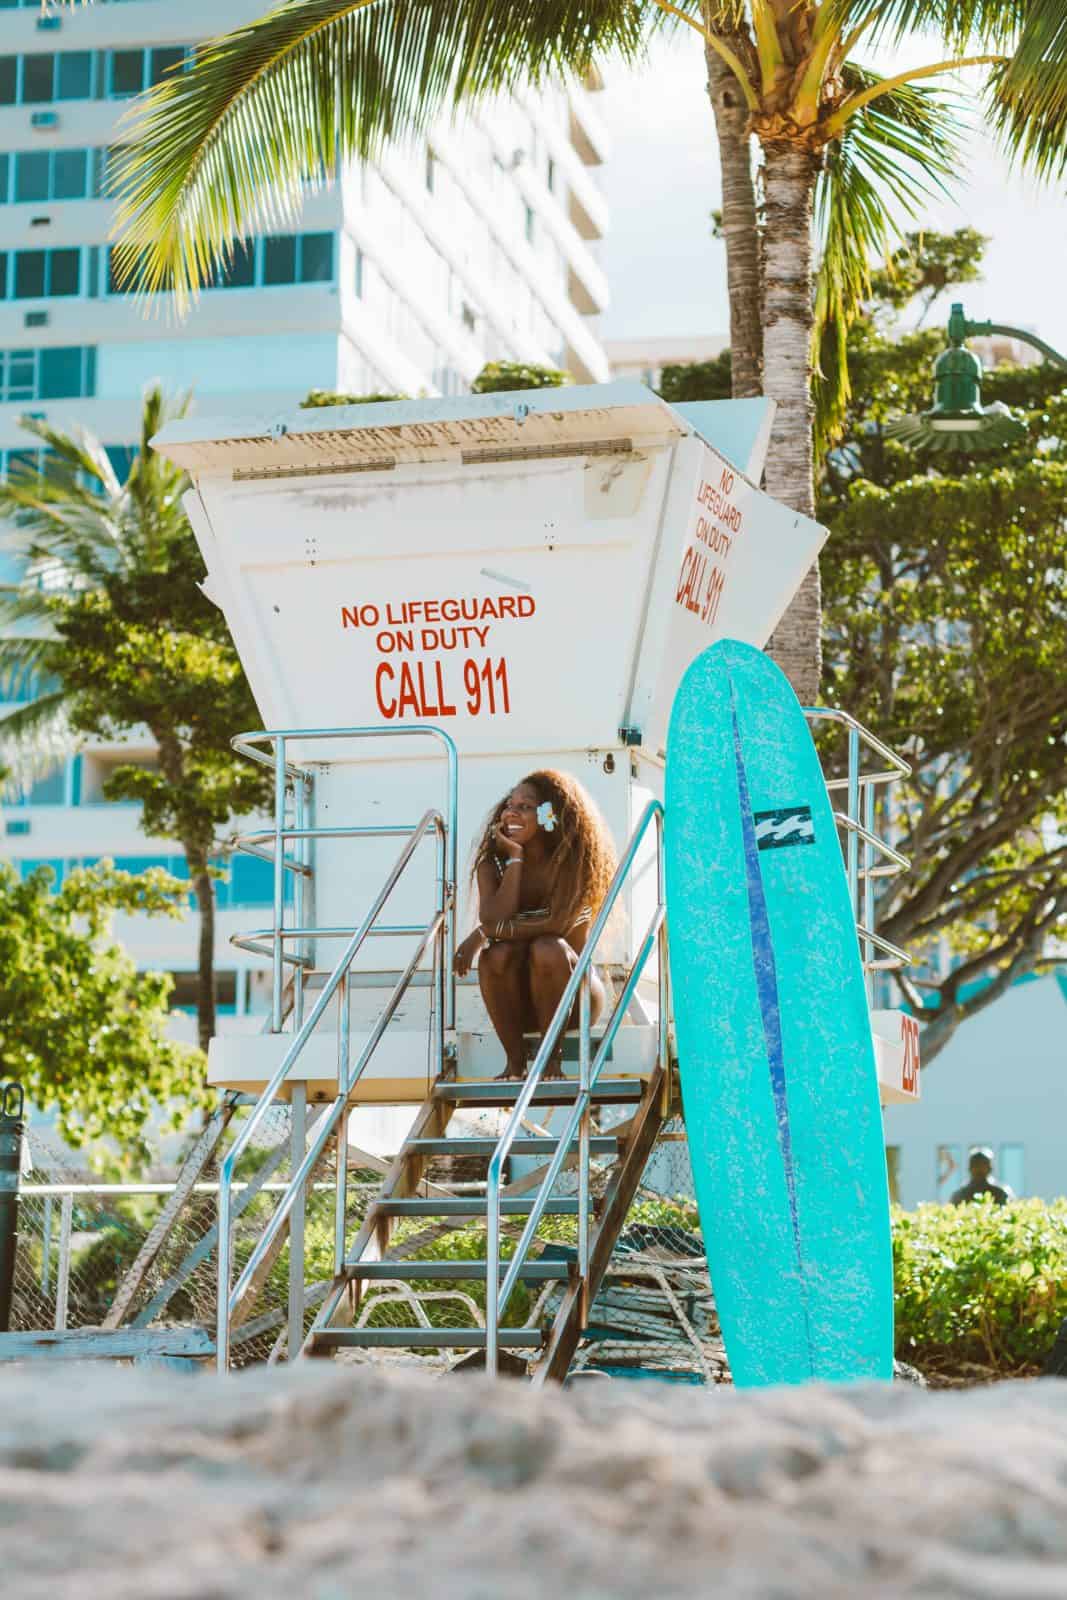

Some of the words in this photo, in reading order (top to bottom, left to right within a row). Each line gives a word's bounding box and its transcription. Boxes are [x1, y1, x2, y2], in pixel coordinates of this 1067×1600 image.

[719, 468, 734, 495] NO
[697, 479, 742, 533] LIFEGUARD
[696, 517, 709, 545] ON
[708, 526, 732, 559] DUTY
[676, 546, 708, 614] CALL
[701, 566, 725, 625] 911
[341, 605, 380, 628] NO
[386, 595, 536, 625] LIFEGUARD
[376, 630, 414, 653] ON
[421, 625, 490, 651] DUTY
[375, 660, 457, 719] CALL
[463, 657, 510, 716] 911
